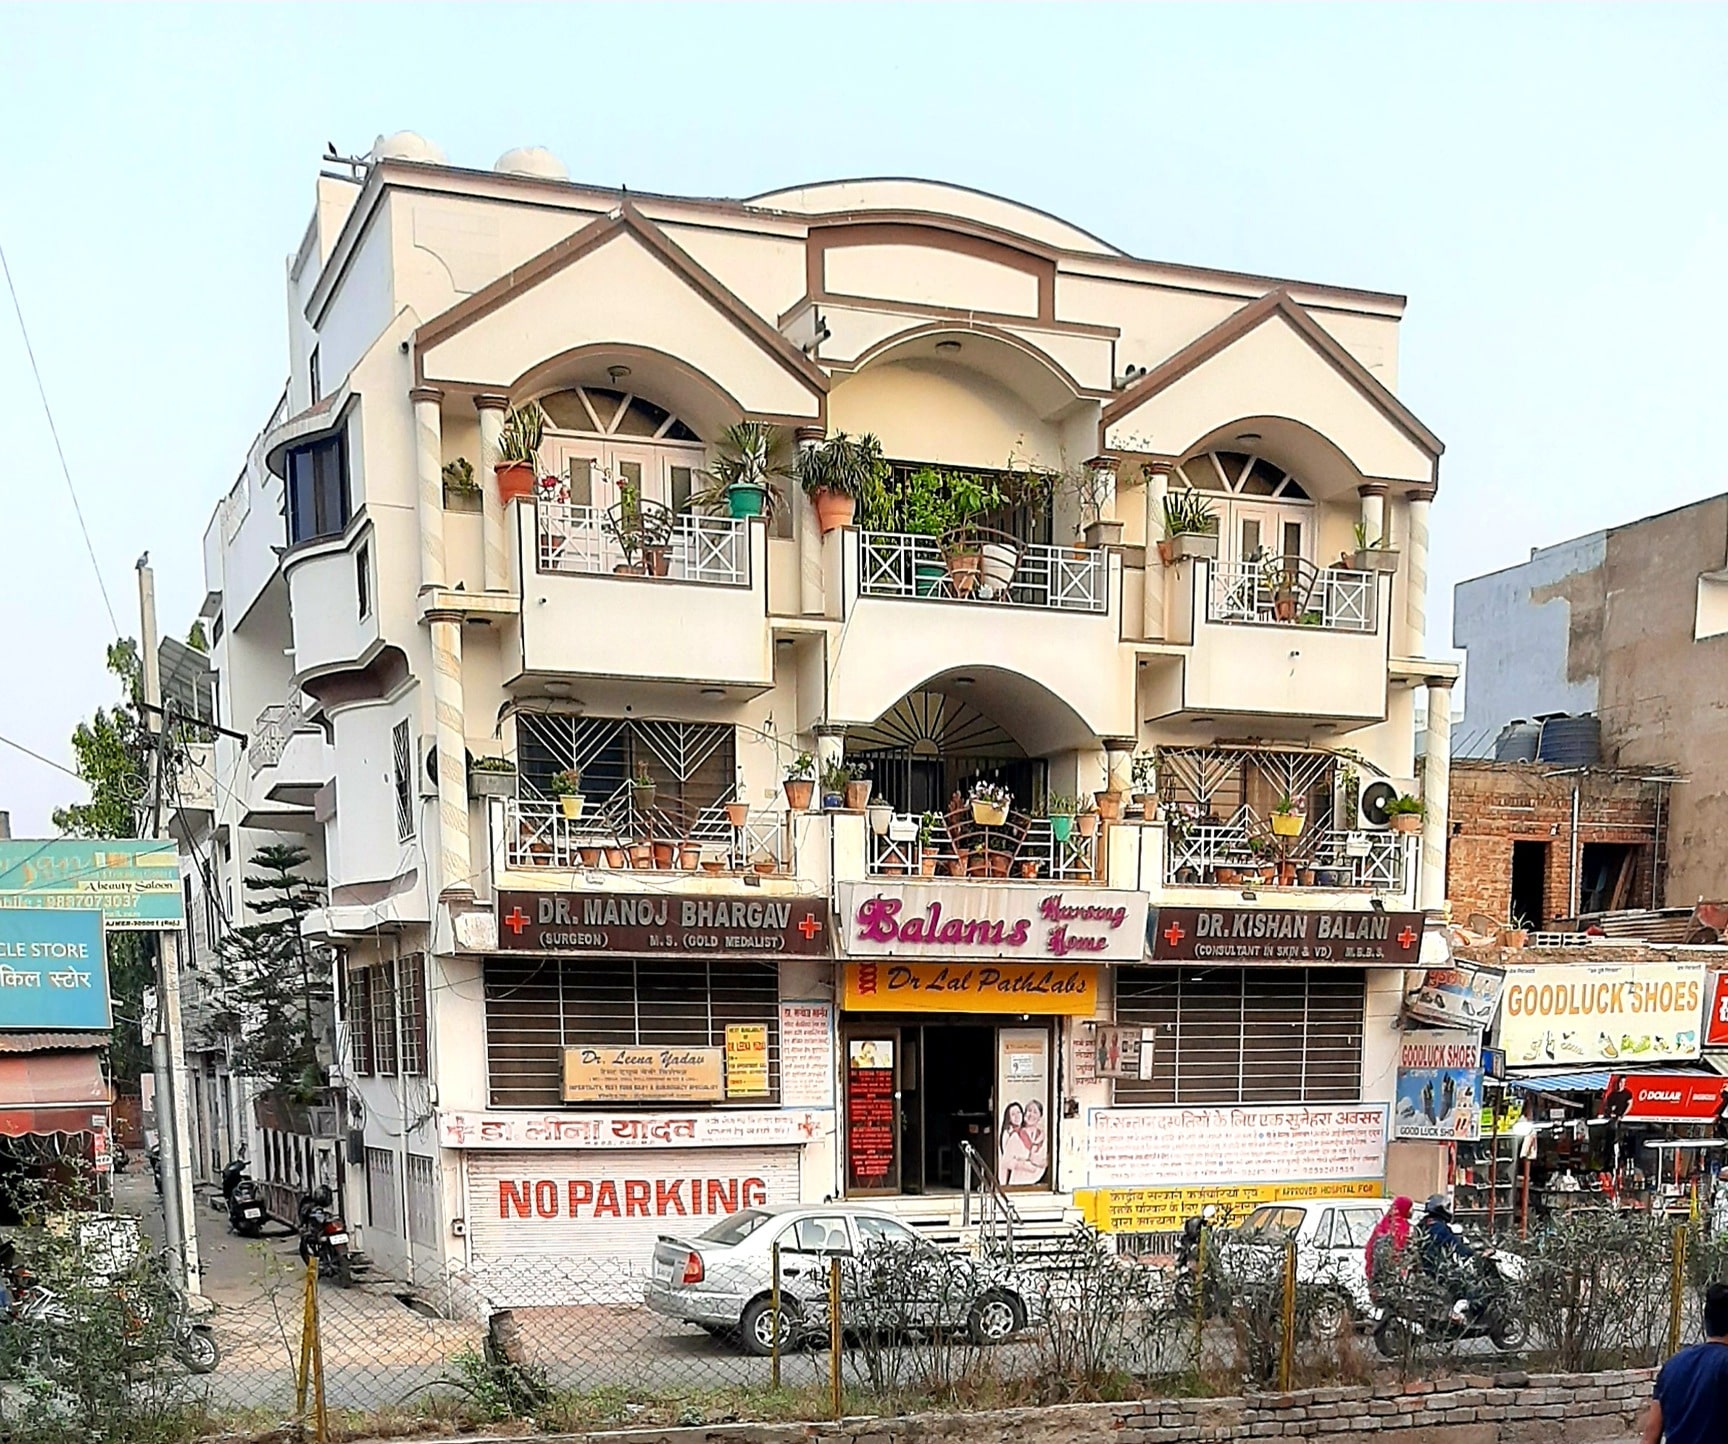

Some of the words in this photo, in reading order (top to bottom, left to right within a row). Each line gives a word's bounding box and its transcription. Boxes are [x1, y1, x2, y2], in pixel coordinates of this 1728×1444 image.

[135, 881, 173, 891] Saloon
[537, 897, 577, 925] DR.
[583, 898, 668, 927] MANOJ
[681, 900, 792, 929] BHARGAV
[1038, 893, 1129, 929] Nursing
[1317, 915, 1392, 940] BALANI
[32, 943, 89, 959] STORE
[539, 931, 609, 947] (SURGEON)
[649, 934, 678, 947] M.S.
[683, 935, 719, 950] (GOLD
[725, 935, 786, 950] MEDALIST)
[1047, 924, 1109, 956] Home
[1194, 946, 1261, 960] (CONSULTANT
[1263, 946, 1274, 957] IN
[1276, 947, 1299, 958] SKIN
[1314, 947, 1333, 960] VD)
[0, 963, 41, 987] किल
[48, 965, 92, 988] स्टोर
[887, 966, 923, 990] Dr
[925, 967, 972, 992] Lal
[977, 968, 1087, 994] PathLabs
[1508, 982, 1625, 1016] GOODLUCK
[1631, 980, 1699, 1013] SHOES
[581, 1050, 606, 1065] Dr.
[612, 1050, 653, 1064] Leena
[660, 1050, 705, 1068] Yadav
[1402, 1044, 1445, 1067] GOODLUCK
[1446, 1044, 1477, 1067] SHOES
[1646, 1090, 1681, 1102] DOLLAR
[1335, 1110, 1383, 1126] अवसर
[611, 1118, 698, 1143] यादव
[1400, 1126, 1419, 1136] GOOD
[1420, 1127, 1438, 1136] LUCK
[498, 1179, 560, 1219] NO
[567, 1177, 767, 1218] PARKING
[1320, 1184, 1355, 1195] HOSPITAL
[1358, 1184, 1373, 1194] FOR
